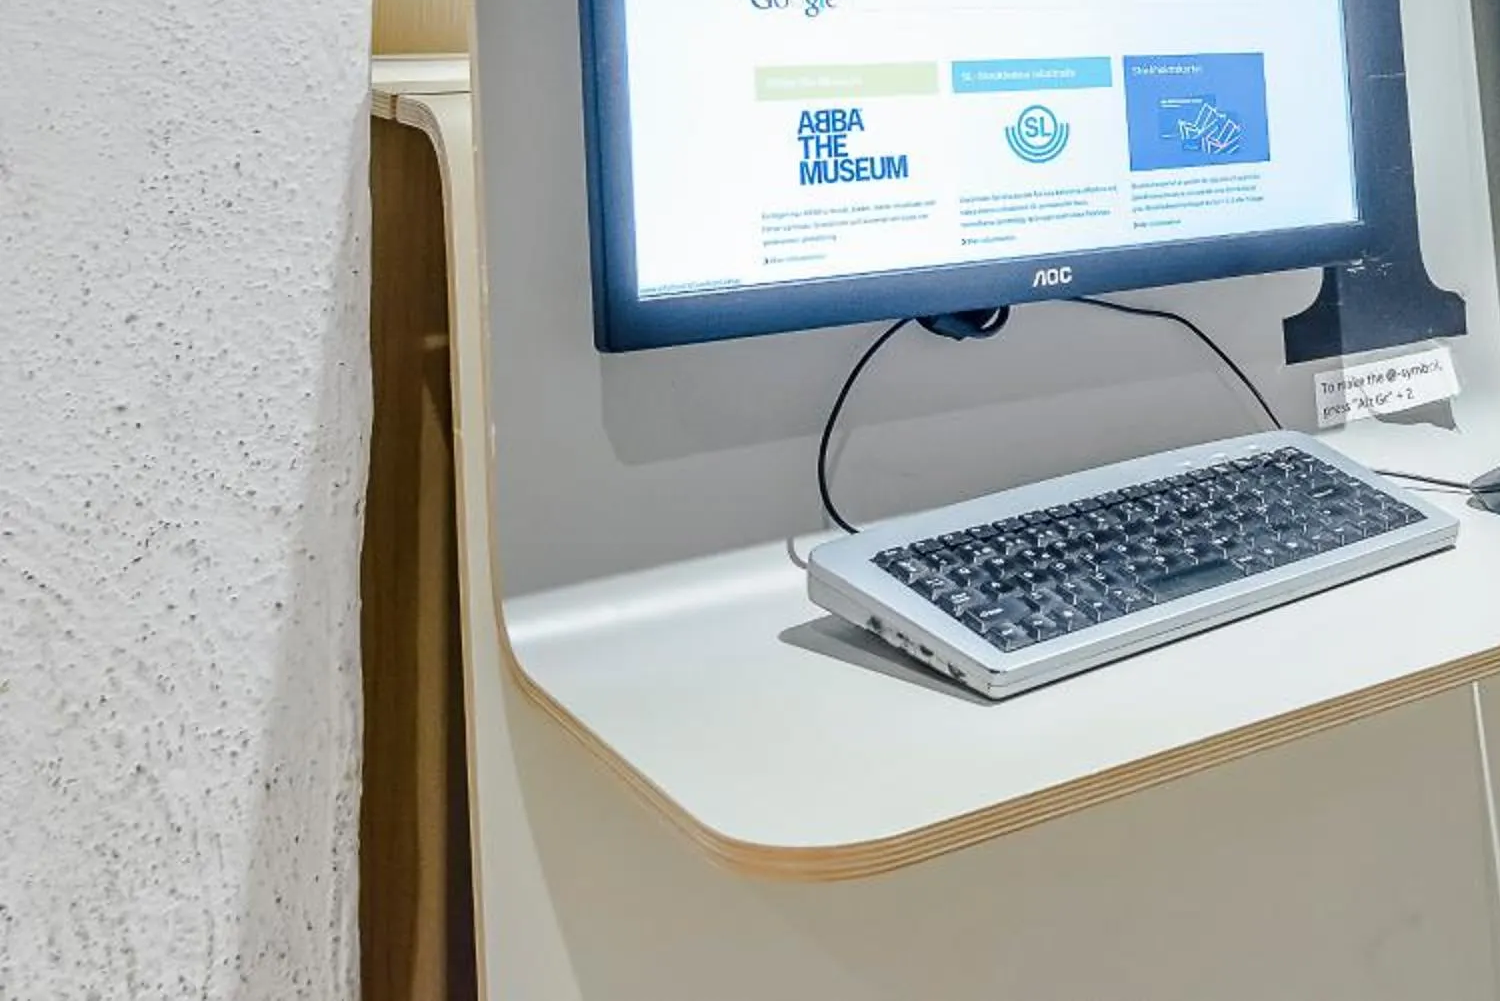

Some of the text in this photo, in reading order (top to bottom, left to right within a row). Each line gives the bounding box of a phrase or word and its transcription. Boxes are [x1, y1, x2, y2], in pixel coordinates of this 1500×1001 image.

[797, 108, 865, 134] ABBA
[1025, 116, 1051, 138] SL
[798, 134, 848, 160] THE
[800, 155, 909, 185] MUSEUM
[1033, 266, 1073, 288] AOC
[1321, 381, 1335, 394] To
[1367, 372, 1384, 386] the
[1323, 403, 1351, 420] press
